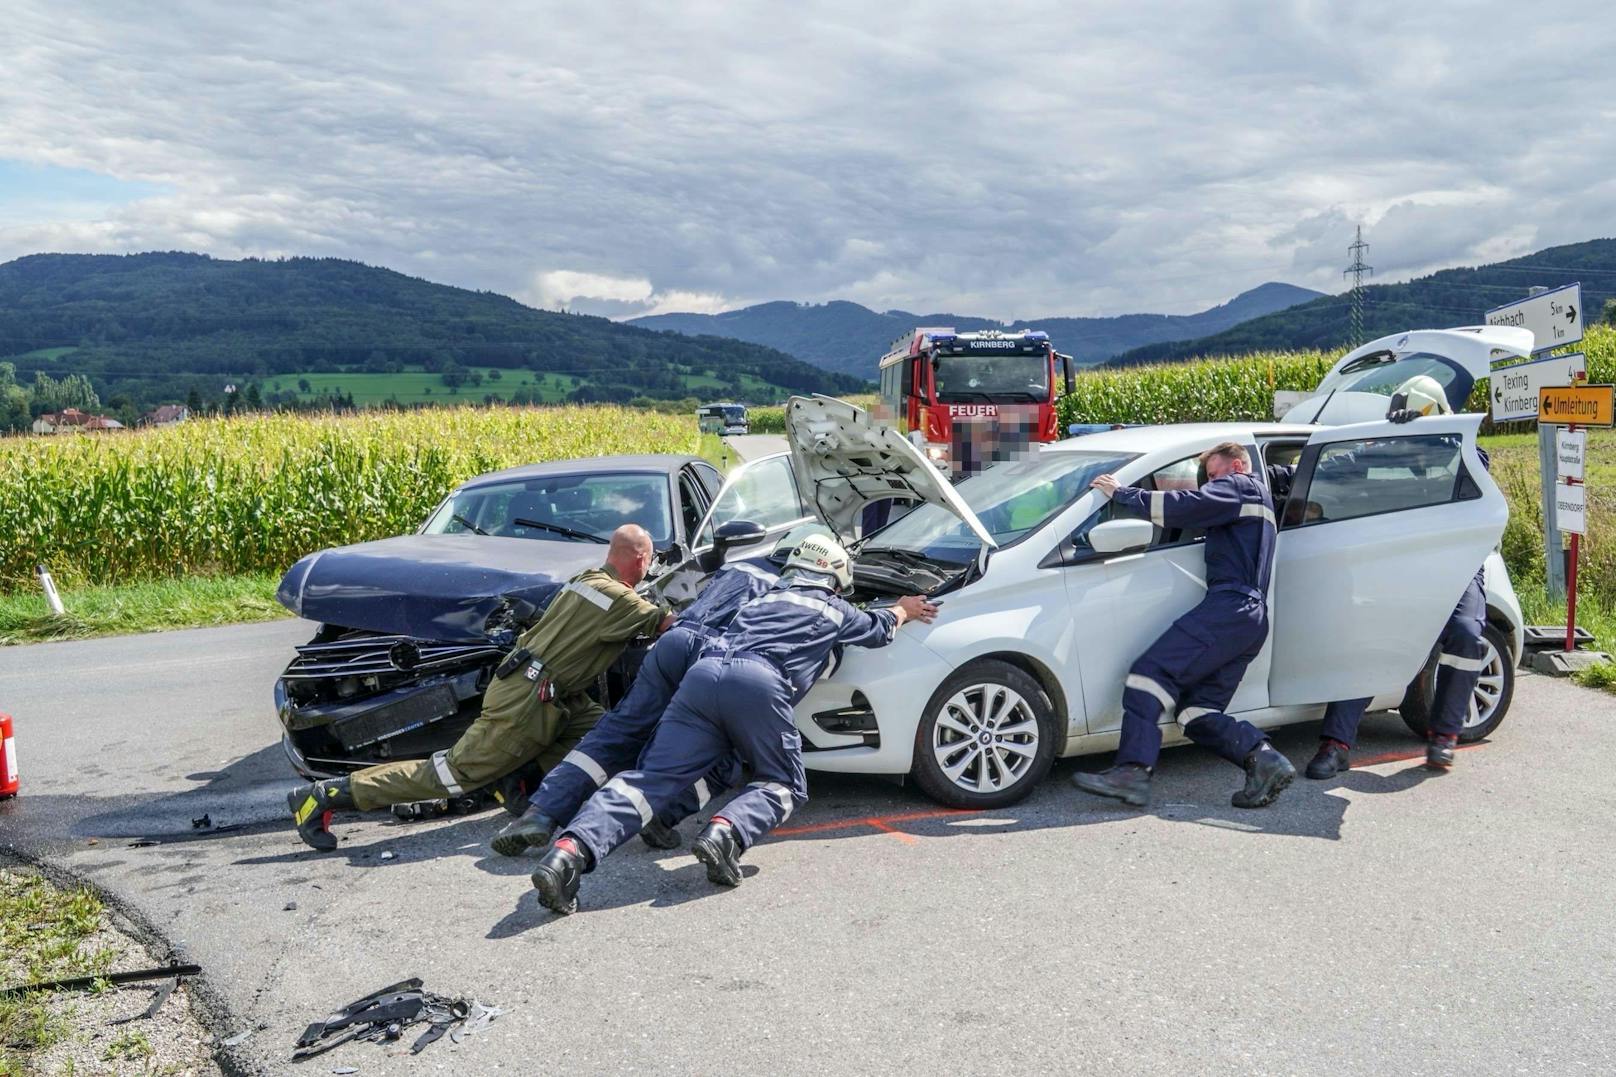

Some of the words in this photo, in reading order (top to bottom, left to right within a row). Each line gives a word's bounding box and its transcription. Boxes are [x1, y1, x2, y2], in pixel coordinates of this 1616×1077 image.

[970, 341, 1015, 349] KIRNBERG
[1503, 372, 1529, 391] Texing
[949, 405, 998, 416] FEUER
[1504, 395, 1539, 413] Kirnberg
[1553, 395, 1598, 420] Umleitung
